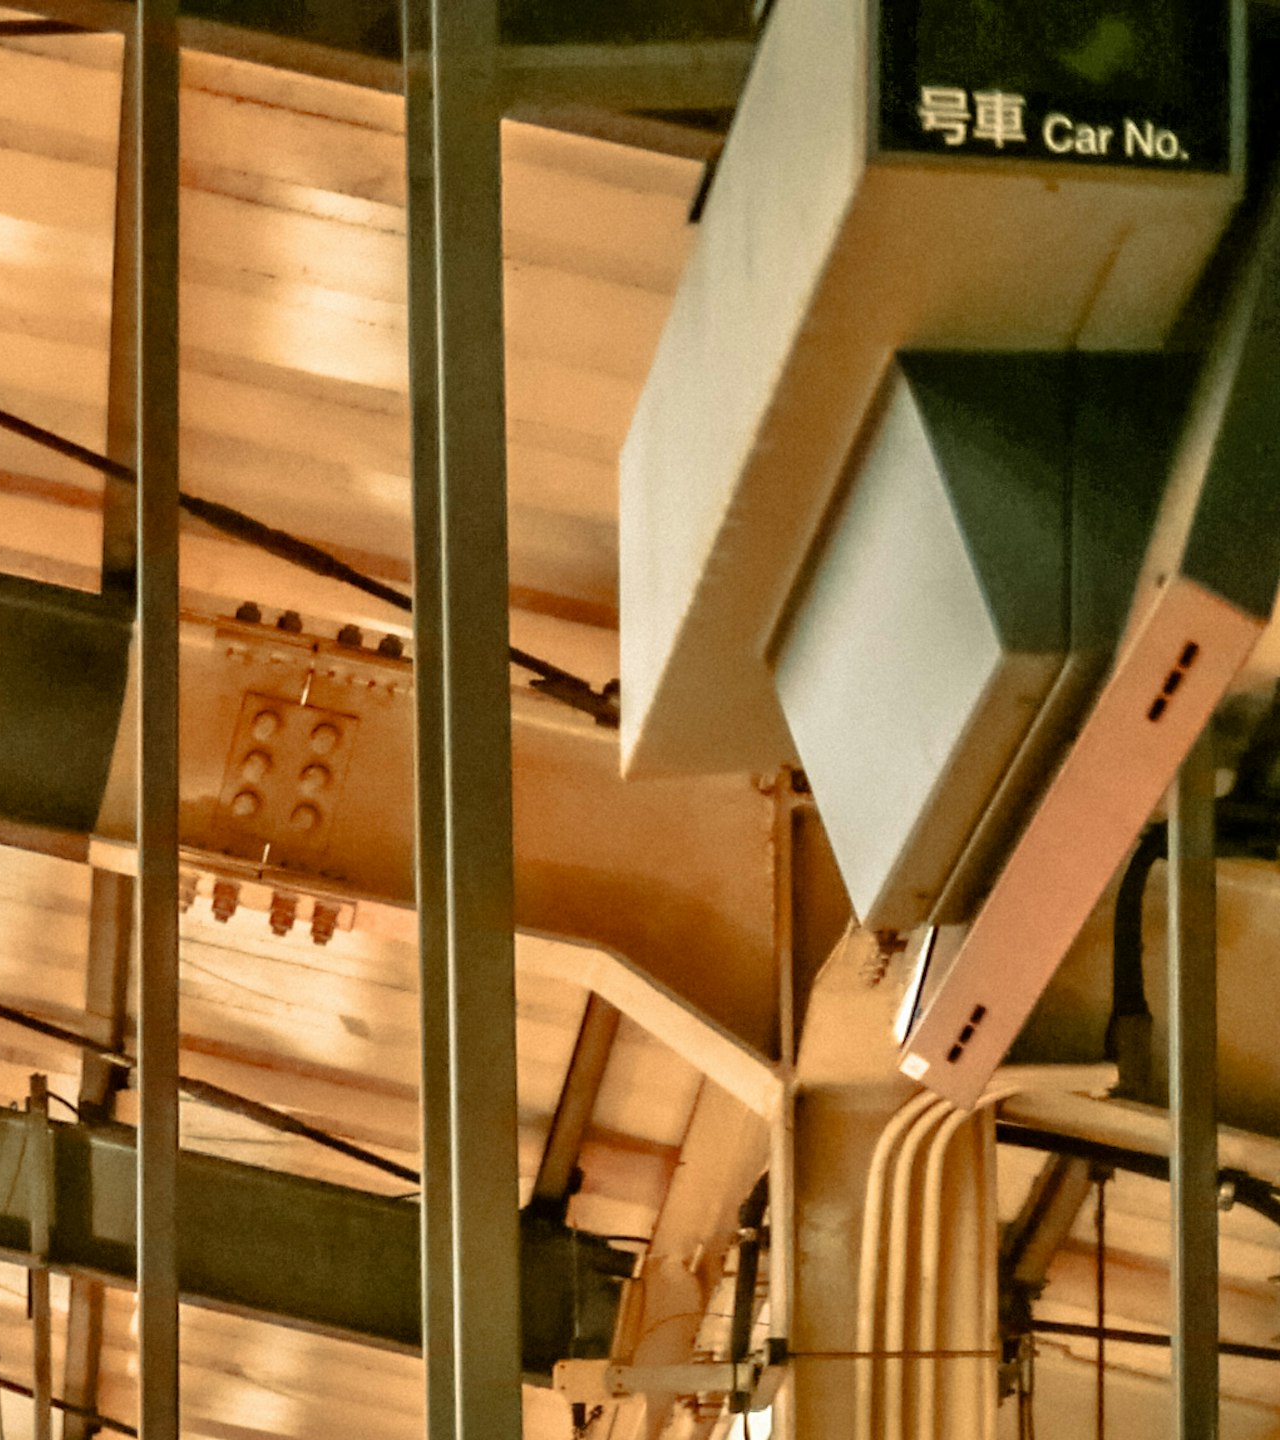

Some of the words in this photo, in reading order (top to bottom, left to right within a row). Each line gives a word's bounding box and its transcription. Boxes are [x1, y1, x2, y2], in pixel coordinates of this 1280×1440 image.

[917, 85, 1027, 147] 号車
[1042, 115, 1113, 158] Car
[1123, 119, 1190, 162] No.
